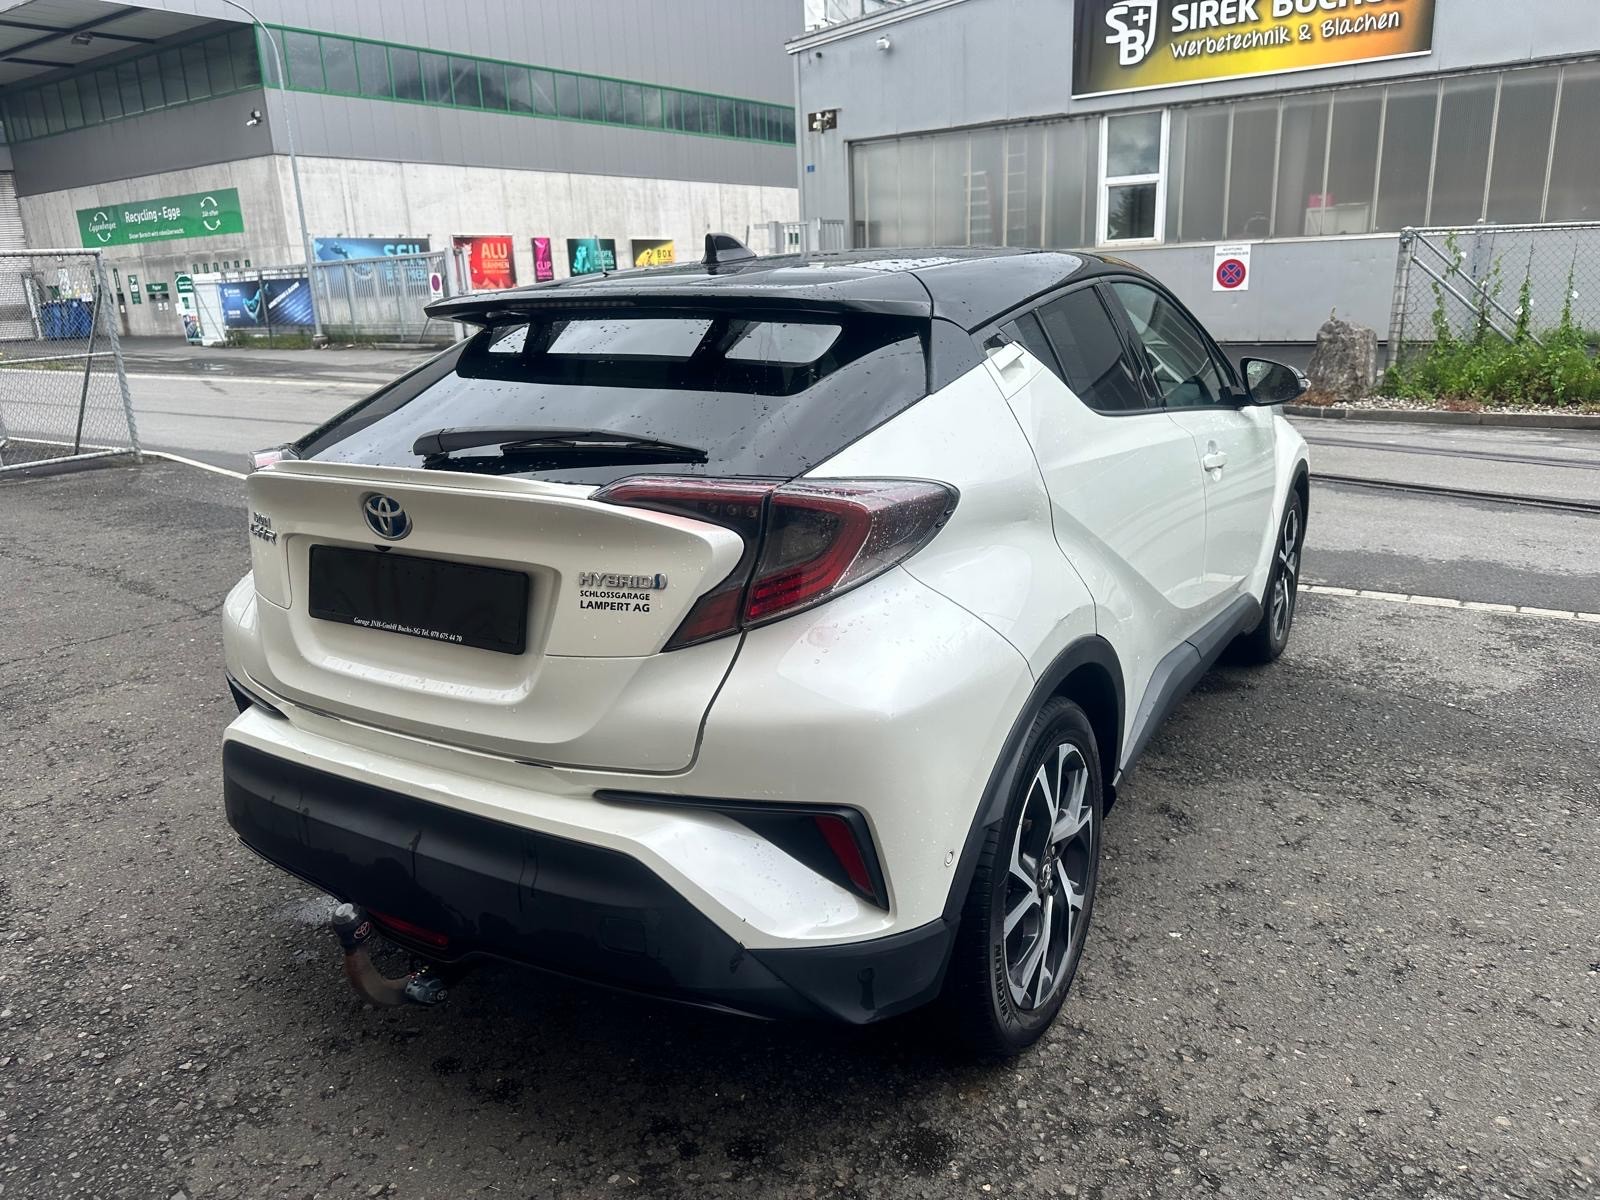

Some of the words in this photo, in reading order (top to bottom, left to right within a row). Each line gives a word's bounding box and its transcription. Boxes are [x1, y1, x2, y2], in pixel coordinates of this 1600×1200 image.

[1171, 0, 1259, 33] SIREK
[1170, 26, 1290, 58] Werbetechnik
[1298, 24, 1312, 41] &
[1321, 11, 1399, 38] Blachen
[125, 207, 157, 224] Recycling
[163, 206, 181, 221] Egge
[481, 243, 507, 259] ALU
[657, 249, 672, 258] BOX
[579, 572, 654, 590] HYBRID
[580, 590, 651, 601] SCHLOSSGARAGE
[580, 600, 631, 612] LAMPERT
[633, 603, 650, 613] AG
[354, 616, 370, 627] Garage
[440, 632, 449, 640] 675
[993, 944, 1009, 1017] MICHELIN
